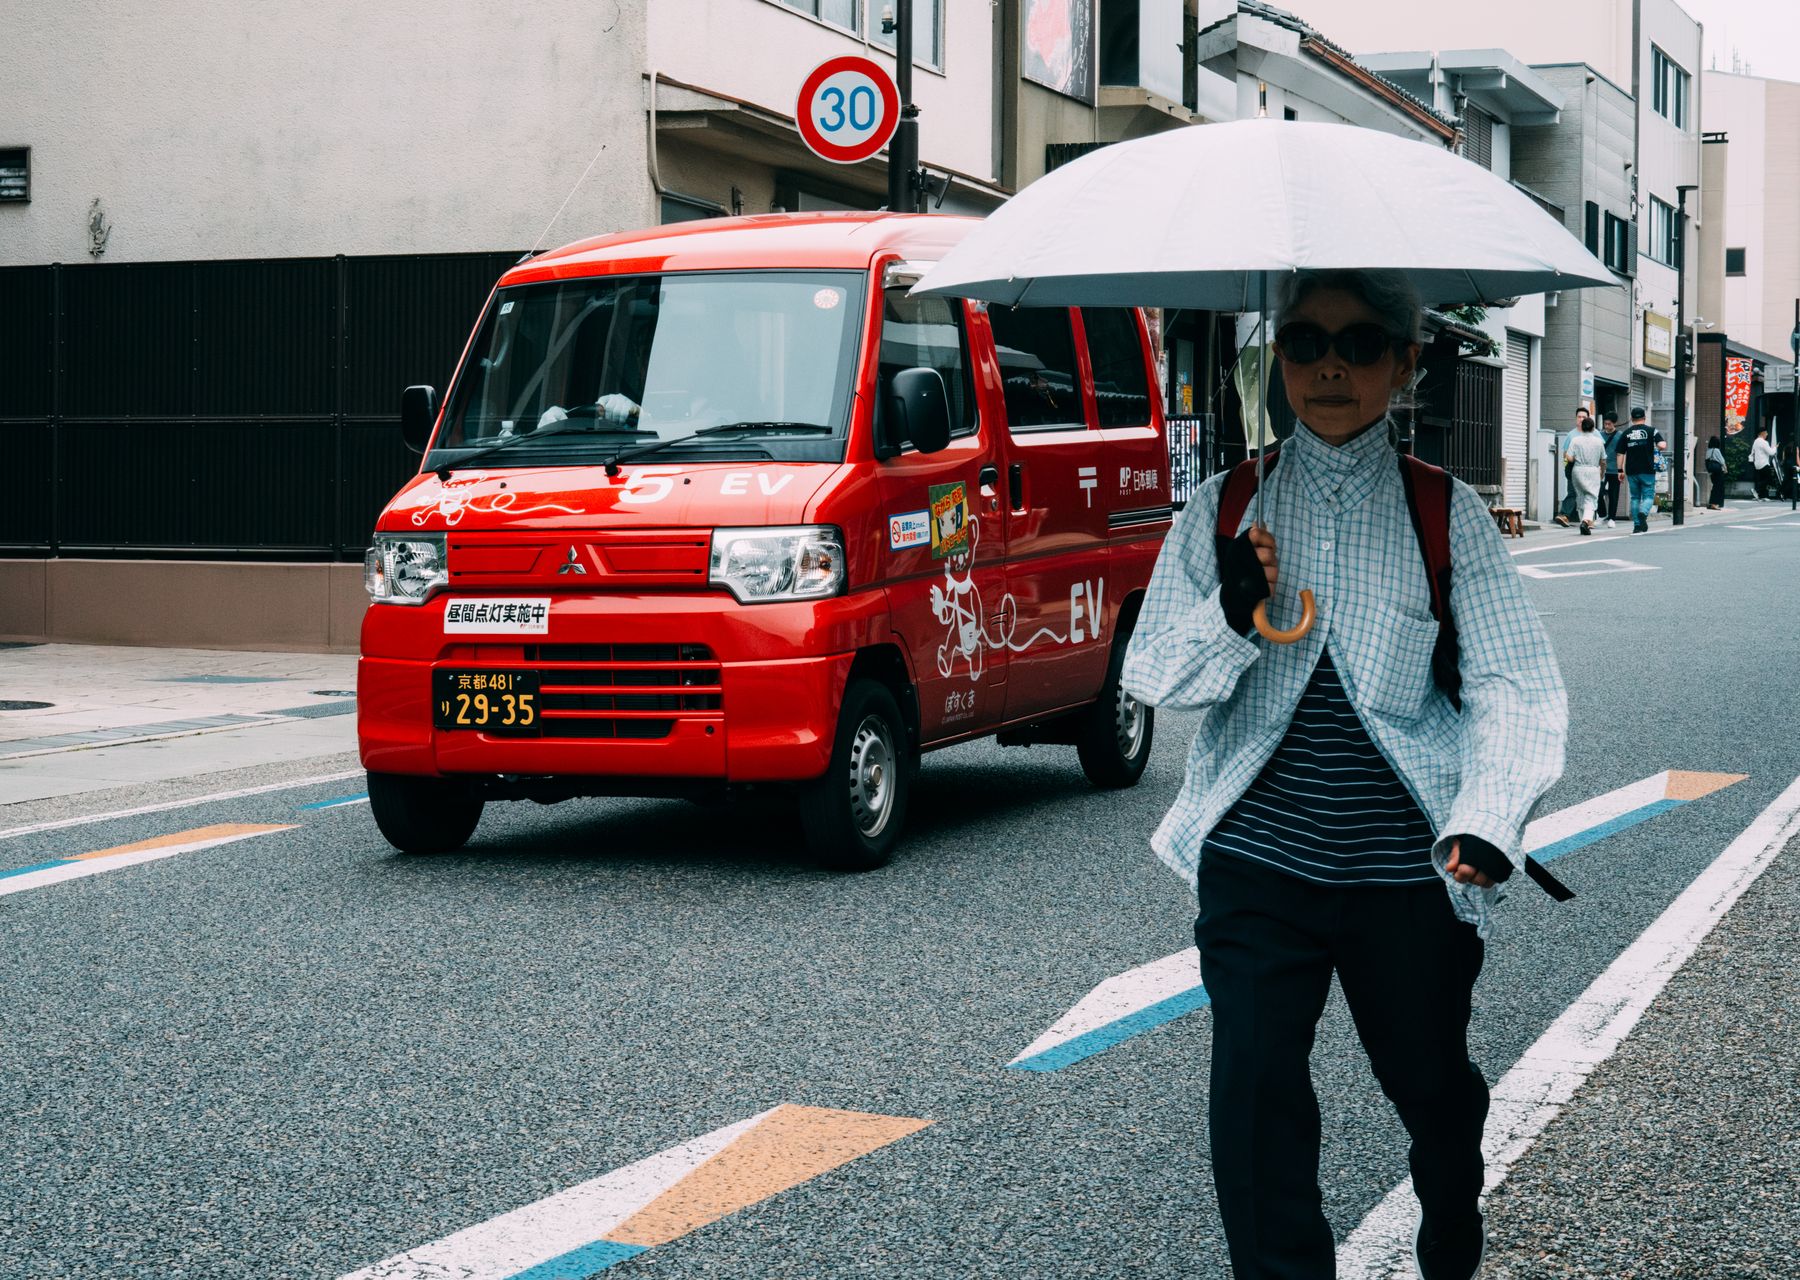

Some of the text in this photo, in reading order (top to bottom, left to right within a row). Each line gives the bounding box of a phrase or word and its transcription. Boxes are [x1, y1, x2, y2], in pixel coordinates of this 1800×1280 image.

[820, 85, 876, 133] 30
[618, 467, 683, 504] 5
[719, 472, 795, 496] EV
[1133, 469, 1158, 491] 日本郵便
[447, 602, 547, 624] 昼間点灯実施中
[1069, 576, 1105, 645] EV
[457, 673, 513, 690] 京都 481
[455, 693, 535, 725] 29-35
